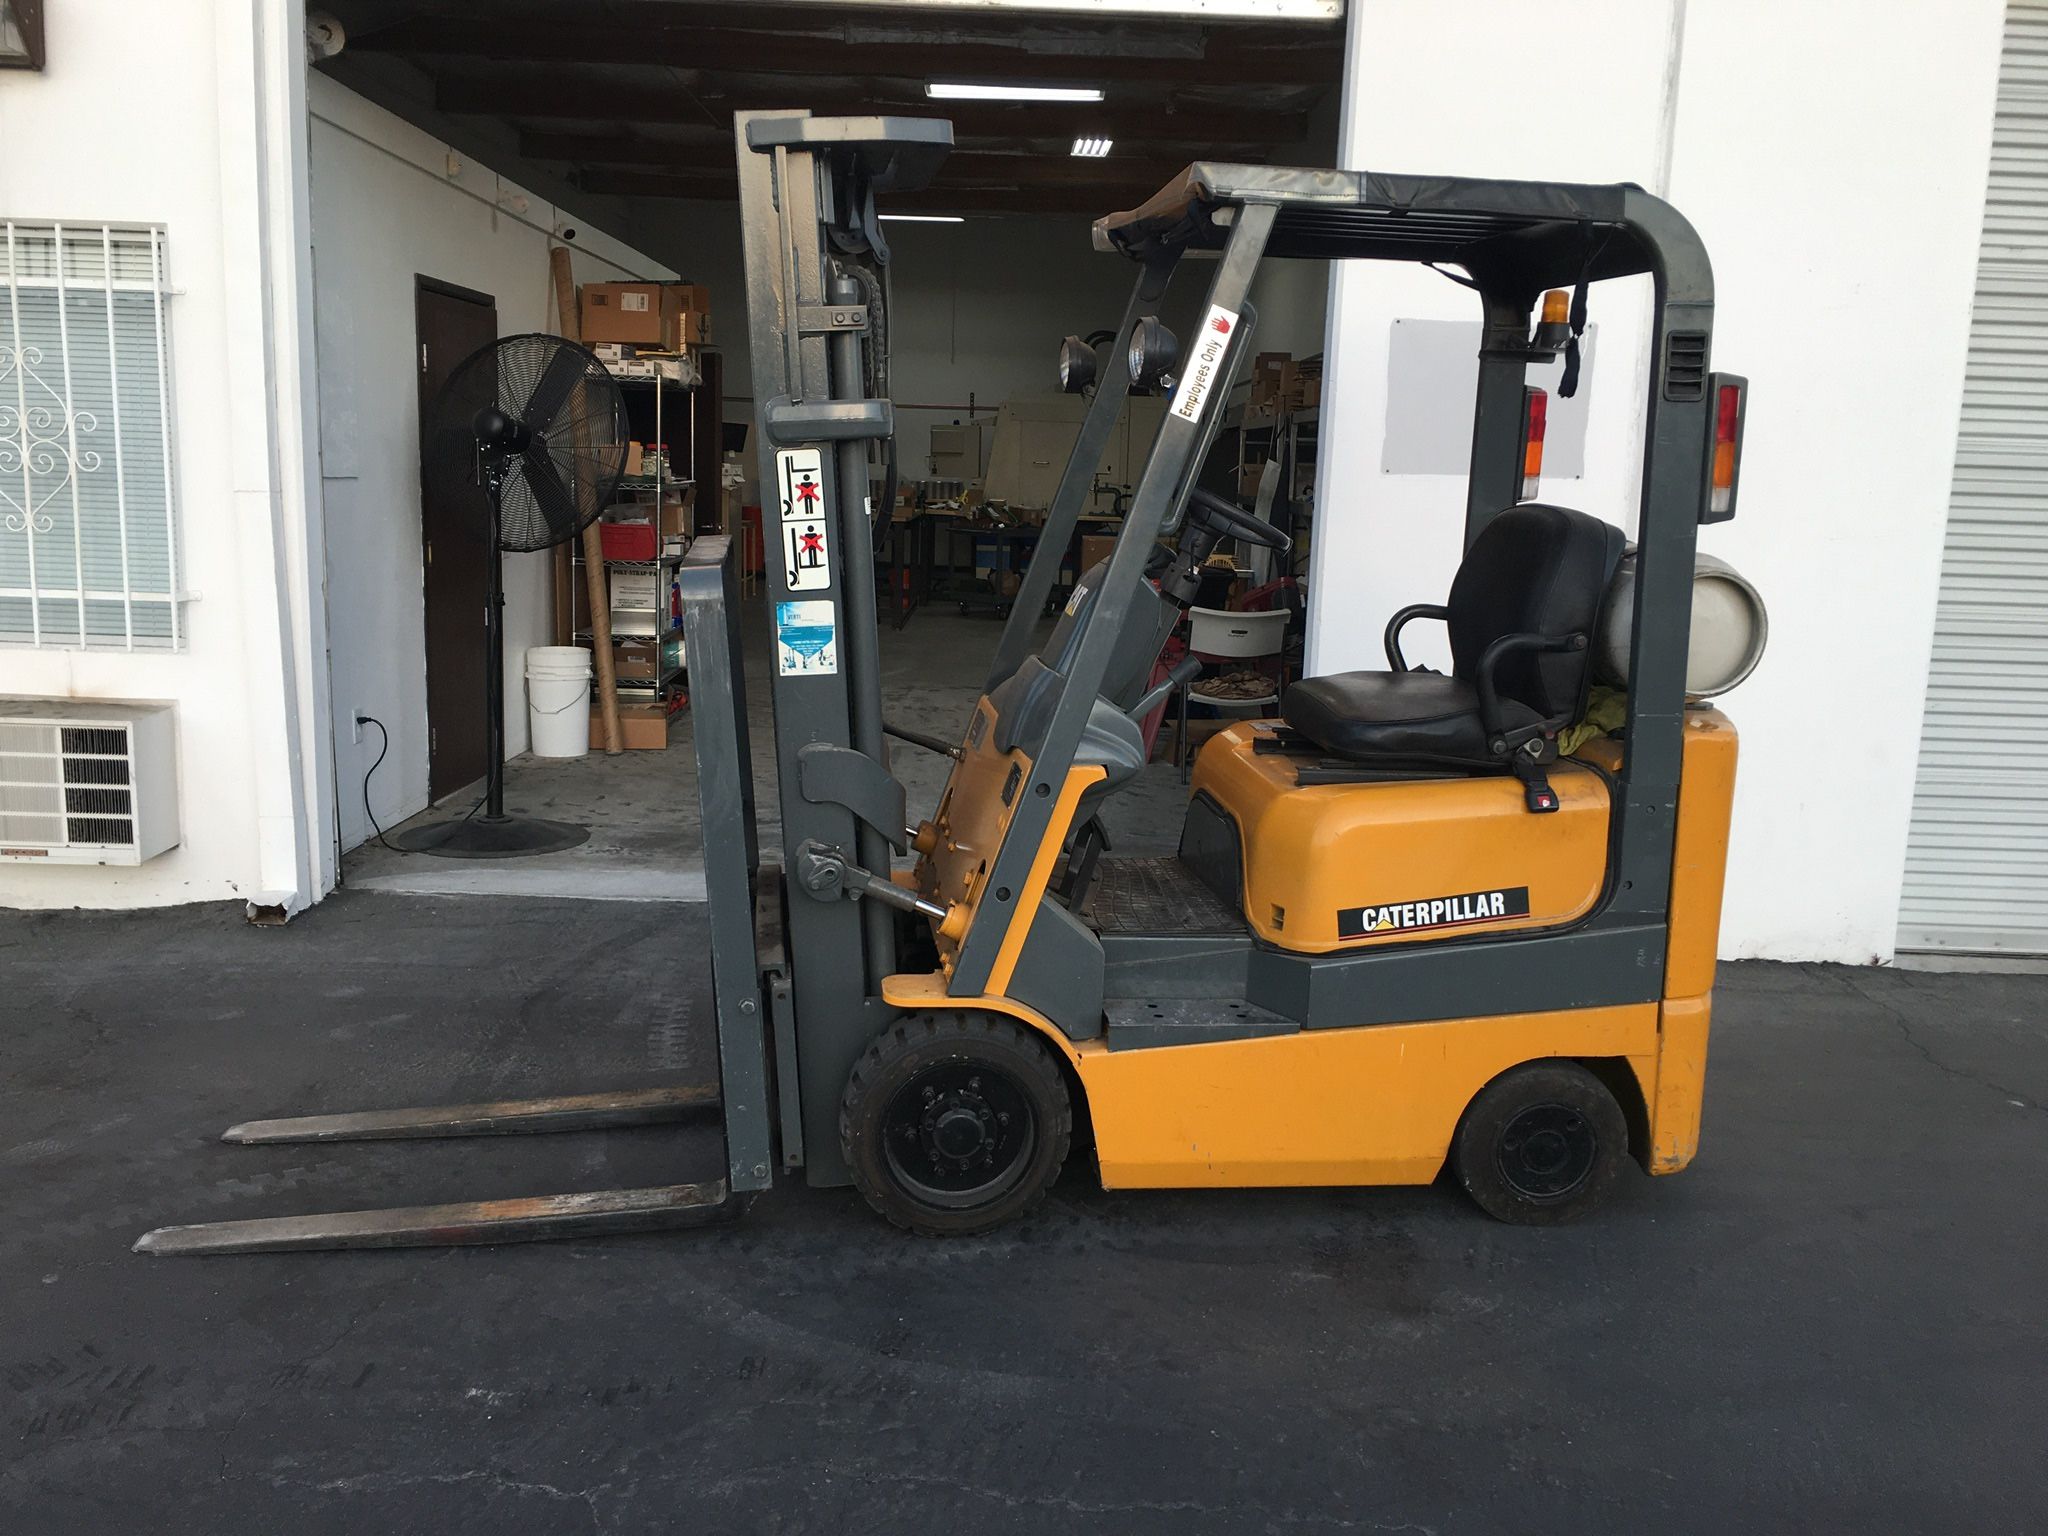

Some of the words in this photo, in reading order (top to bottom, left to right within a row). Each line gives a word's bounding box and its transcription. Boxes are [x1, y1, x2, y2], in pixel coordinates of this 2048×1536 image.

[1179, 364, 1211, 418] Employees
[1200, 339, 1223, 363] Only
[1064, 583, 1089, 617] CAT
[1362, 892, 1505, 932] CATERPILLAR
